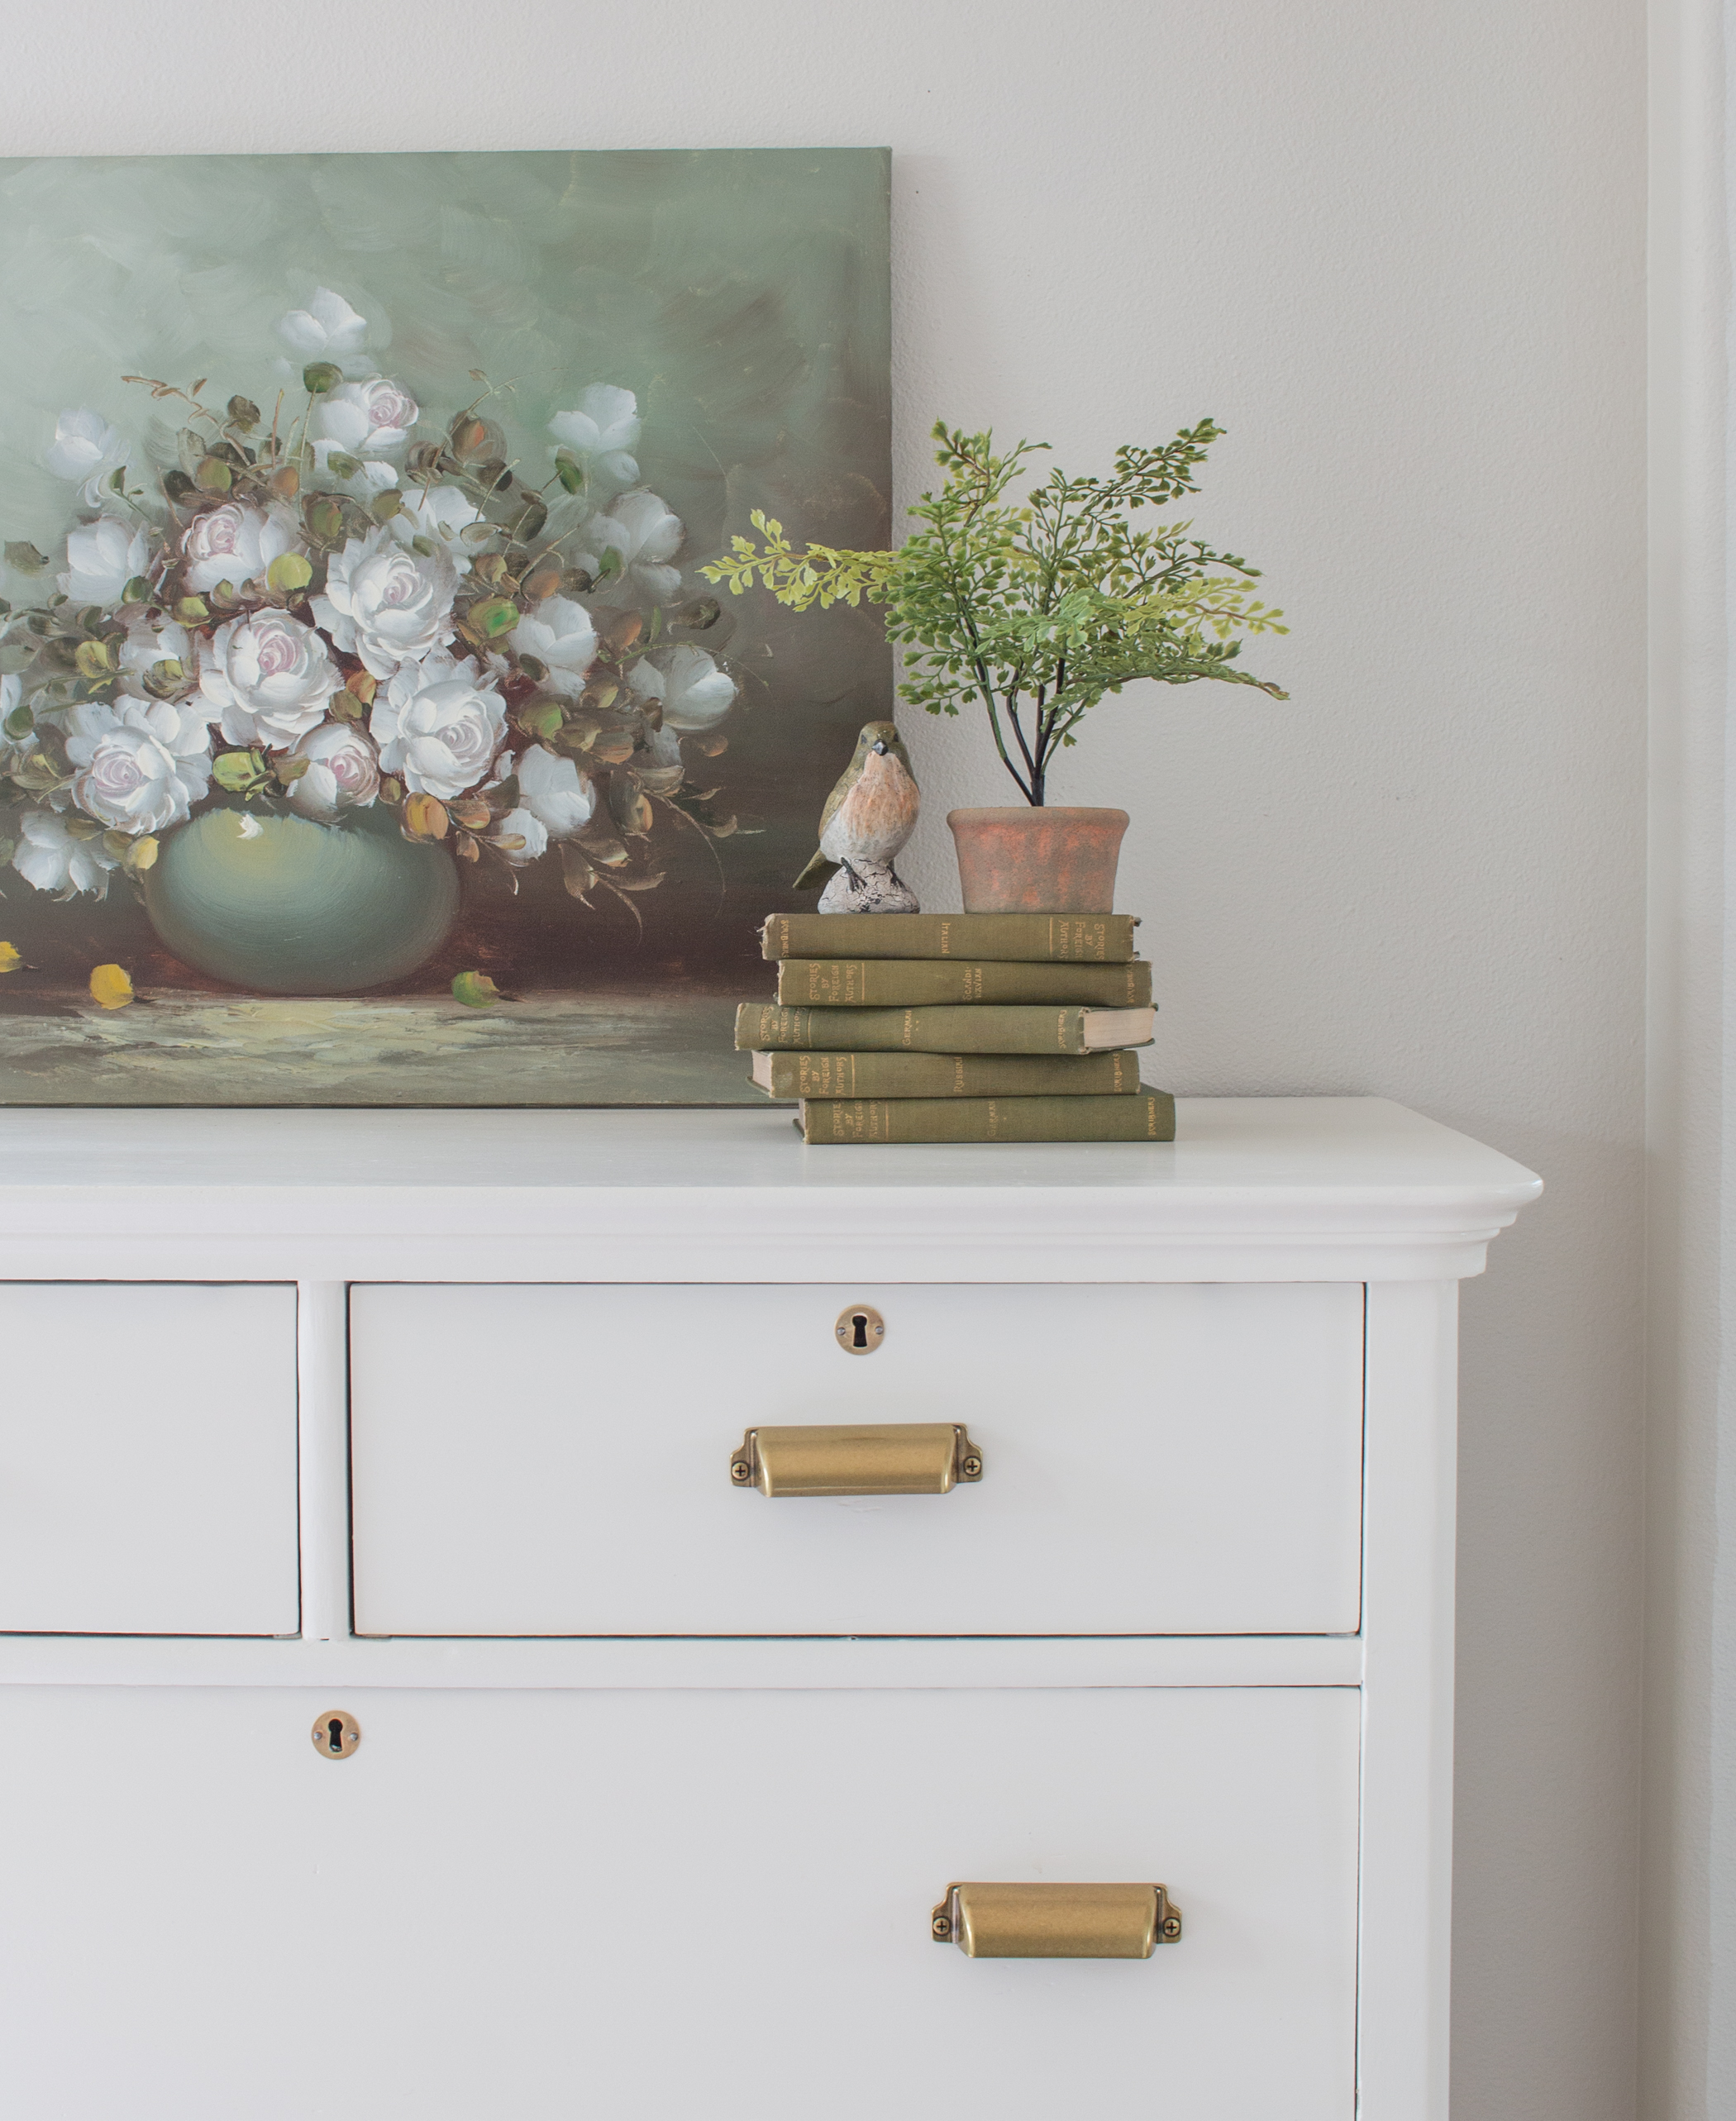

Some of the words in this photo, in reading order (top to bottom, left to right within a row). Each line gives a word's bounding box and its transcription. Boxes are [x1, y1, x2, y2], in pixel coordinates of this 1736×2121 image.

[941, 922, 951, 954] ITALIAN
[1058, 920, 1070, 959] AUTHORS
[1074, 921, 1085, 958] FOREIGN
[1085, 934, 1094, 946] BY
[1094, 923, 1105, 960] STORIES
[809, 963, 821, 1001] STORIES
[821, 977, 830, 989] BY
[829, 965, 842, 1002] FOREIGN
[845, 964, 857, 1003] AUTHORS
[760, 1006, 774, 1041] STORIES
[770, 1019, 779, 1031] BY
[902, 1010, 912, 1046] GERMAN
[1057, 1009, 1067, 1049] SCRIBNERS
[799, 1056, 811, 1094] STORIES
[812, 1070, 820, 1082] BY
[819, 1057, 832, 1095] FOREIGN
[836, 1056, 847, 1096] AUTHORS
[954, 1056, 964, 1092] RUSSIAN
[1114, 1053, 1123, 1092] SCRIBNERS
[845, 1113, 854, 1125] BY
[1147, 1097, 1157, 1136] SCRIBNERS
